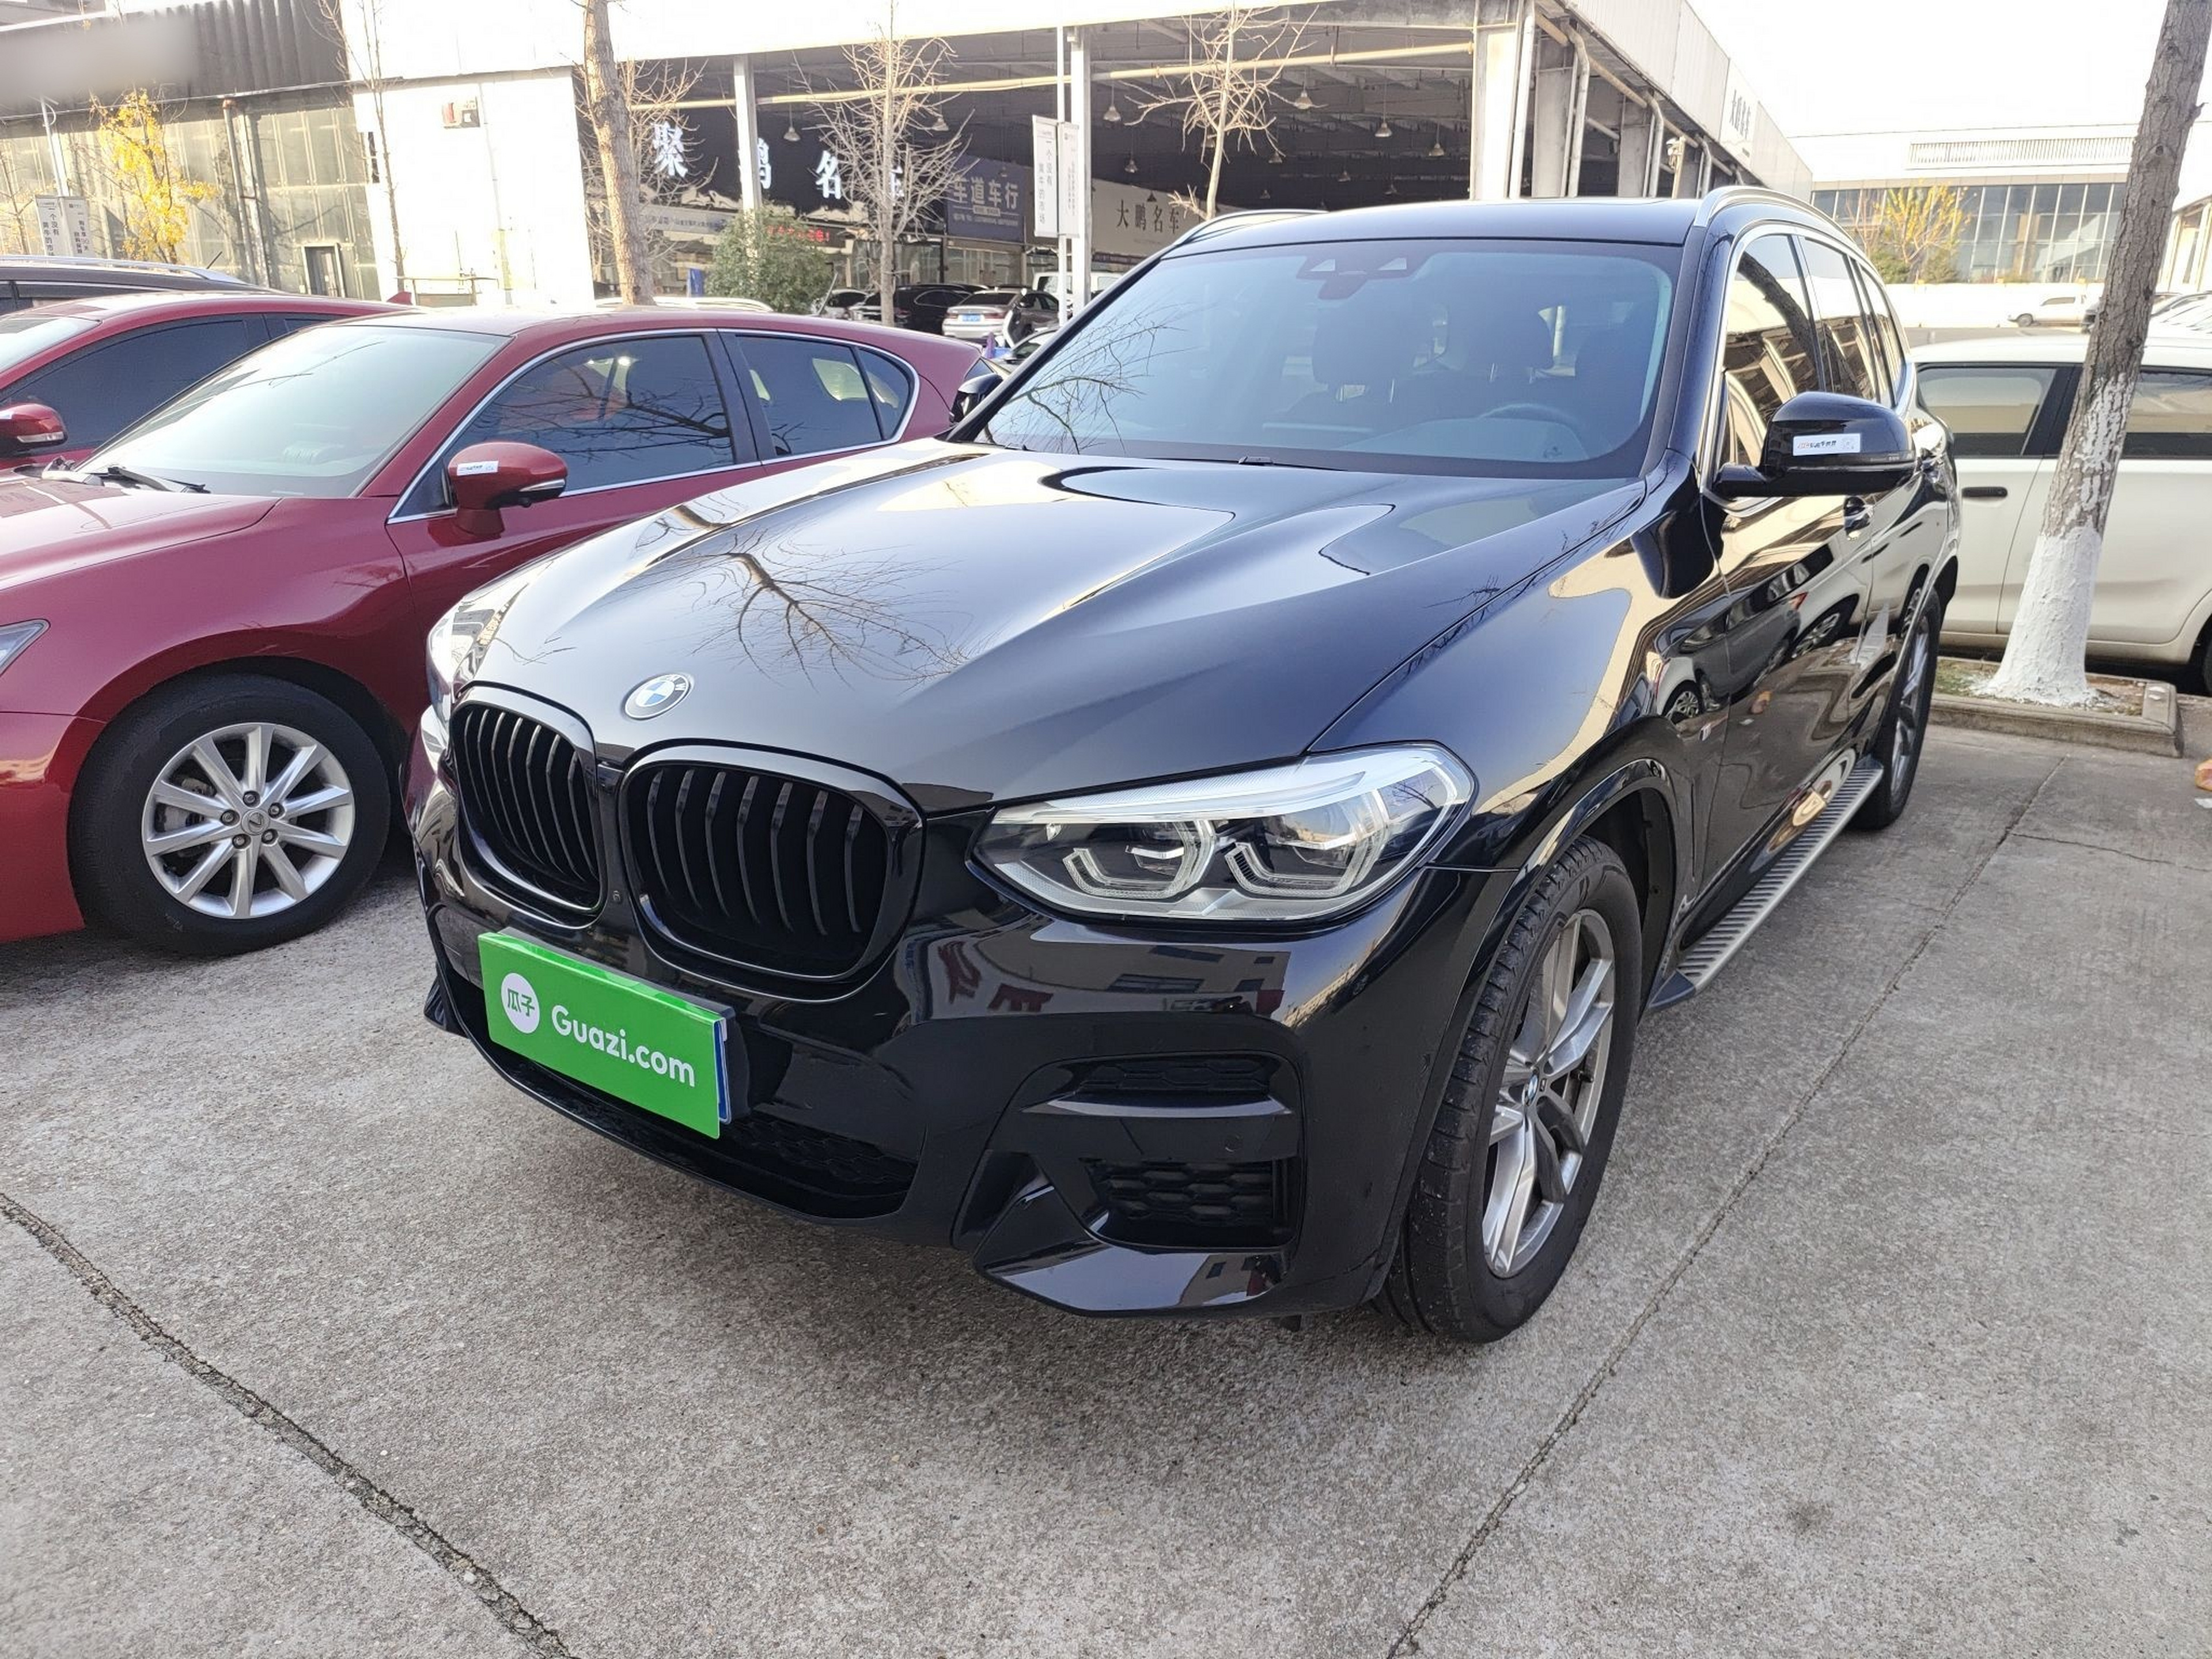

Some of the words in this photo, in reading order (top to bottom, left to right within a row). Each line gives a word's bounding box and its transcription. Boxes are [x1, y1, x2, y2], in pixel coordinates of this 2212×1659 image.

[1116, 199, 1179, 233] 大鹏名车
[507, 988, 535, 1017] 瓜子
[551, 1005, 695, 1087] Guazi.com
